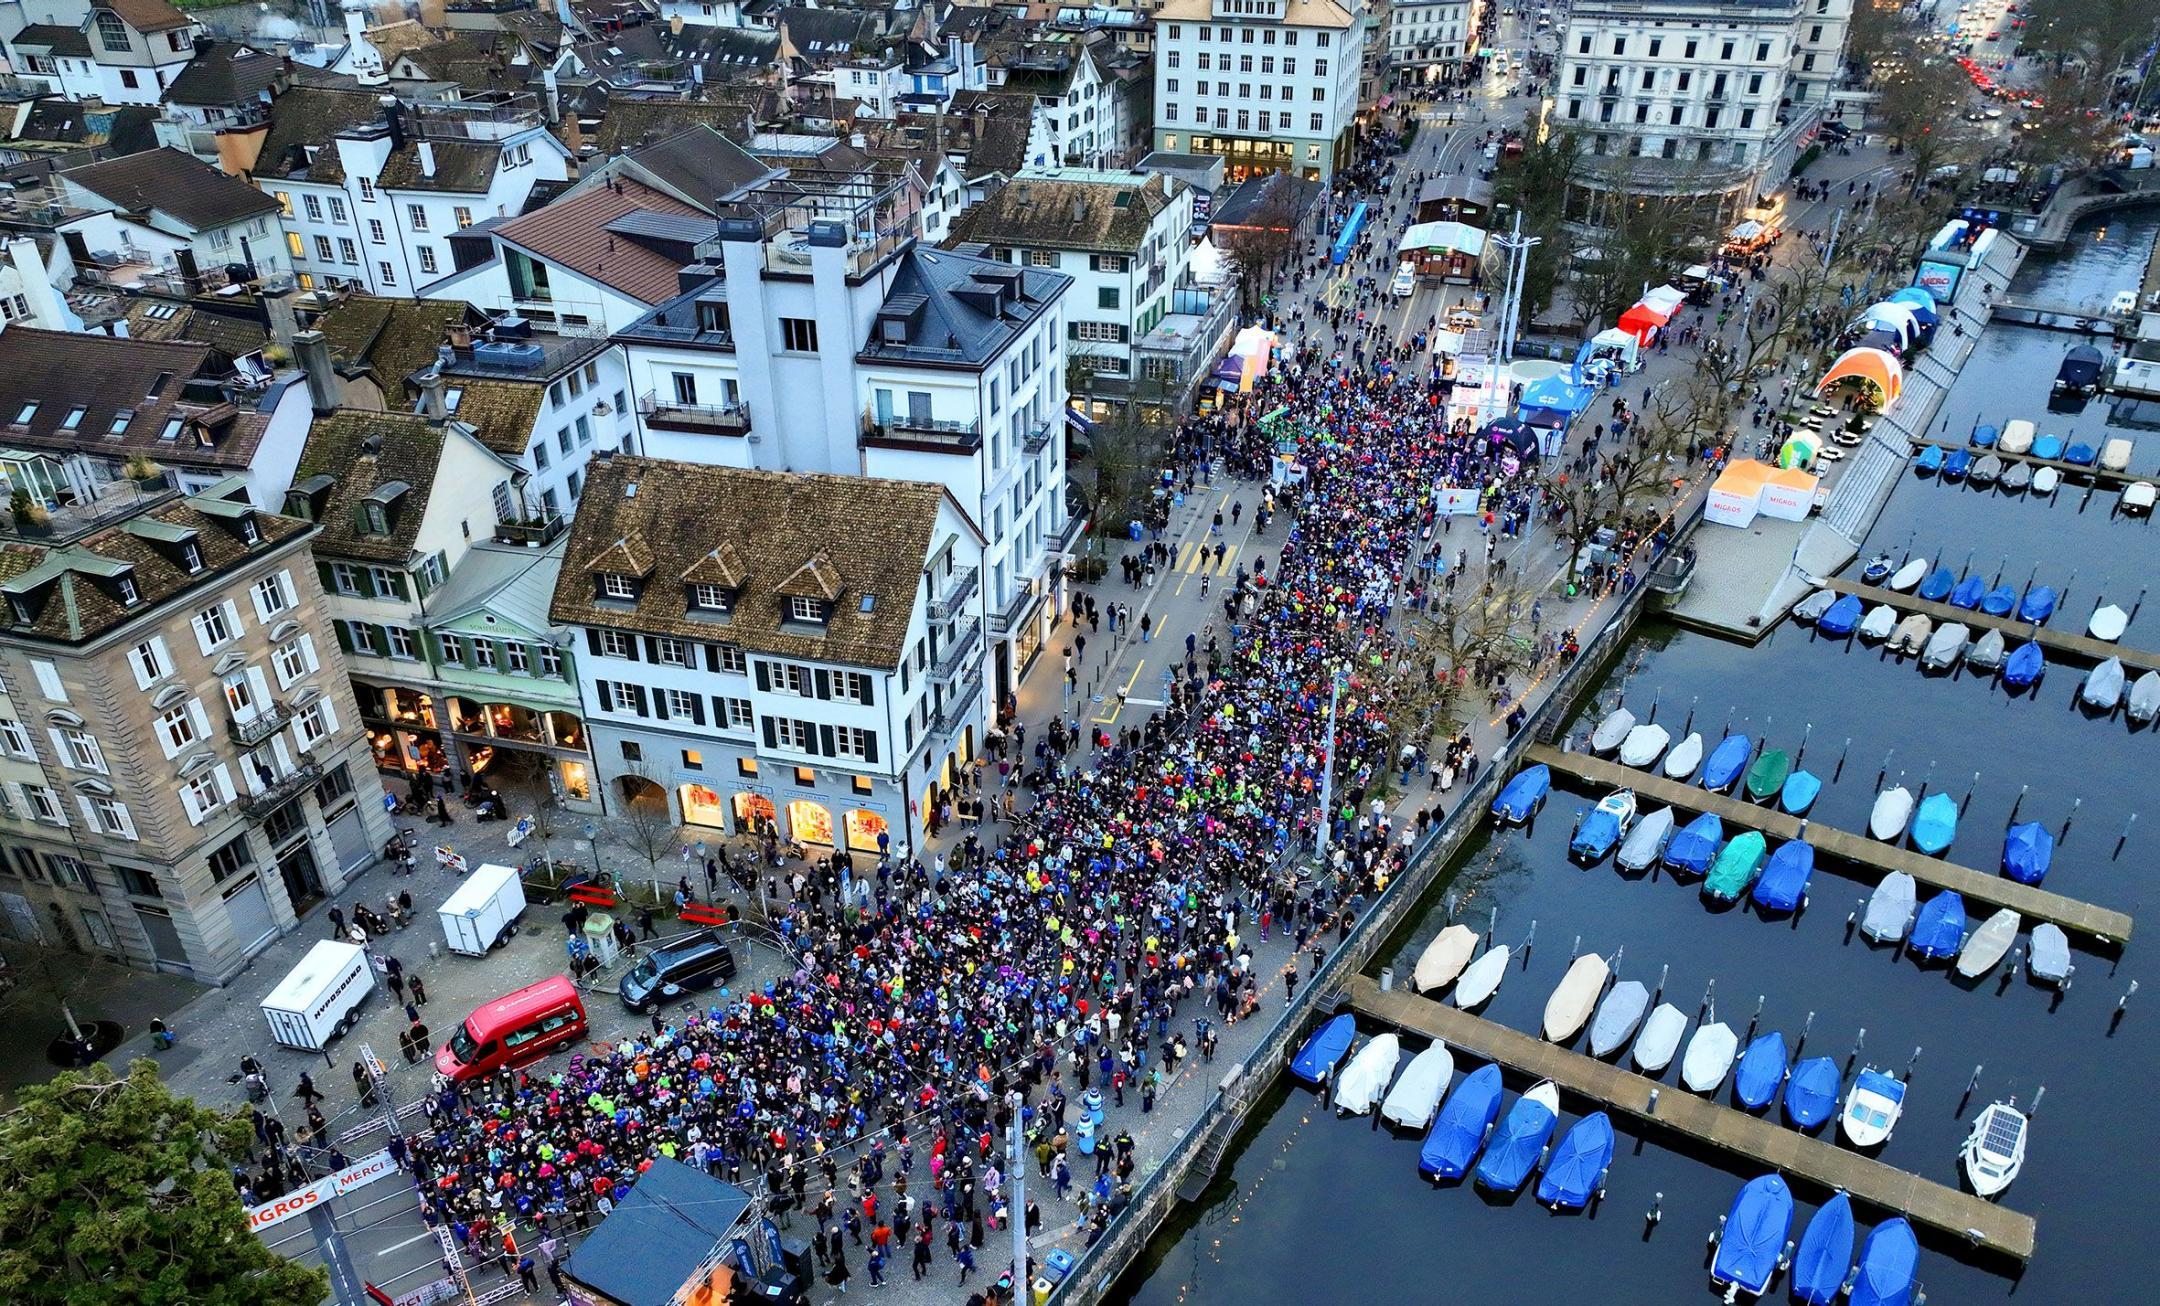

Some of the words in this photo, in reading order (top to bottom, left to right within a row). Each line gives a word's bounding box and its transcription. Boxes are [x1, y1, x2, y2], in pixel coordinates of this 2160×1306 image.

[1714, 503, 1741, 513] MIGROS
[1770, 496, 1797, 507] MIGROS
[314, 965, 362, 1020] HYPOSOUND
[340, 1161, 384, 1186] MERCI
[246, 1190, 318, 1229] IGROS
